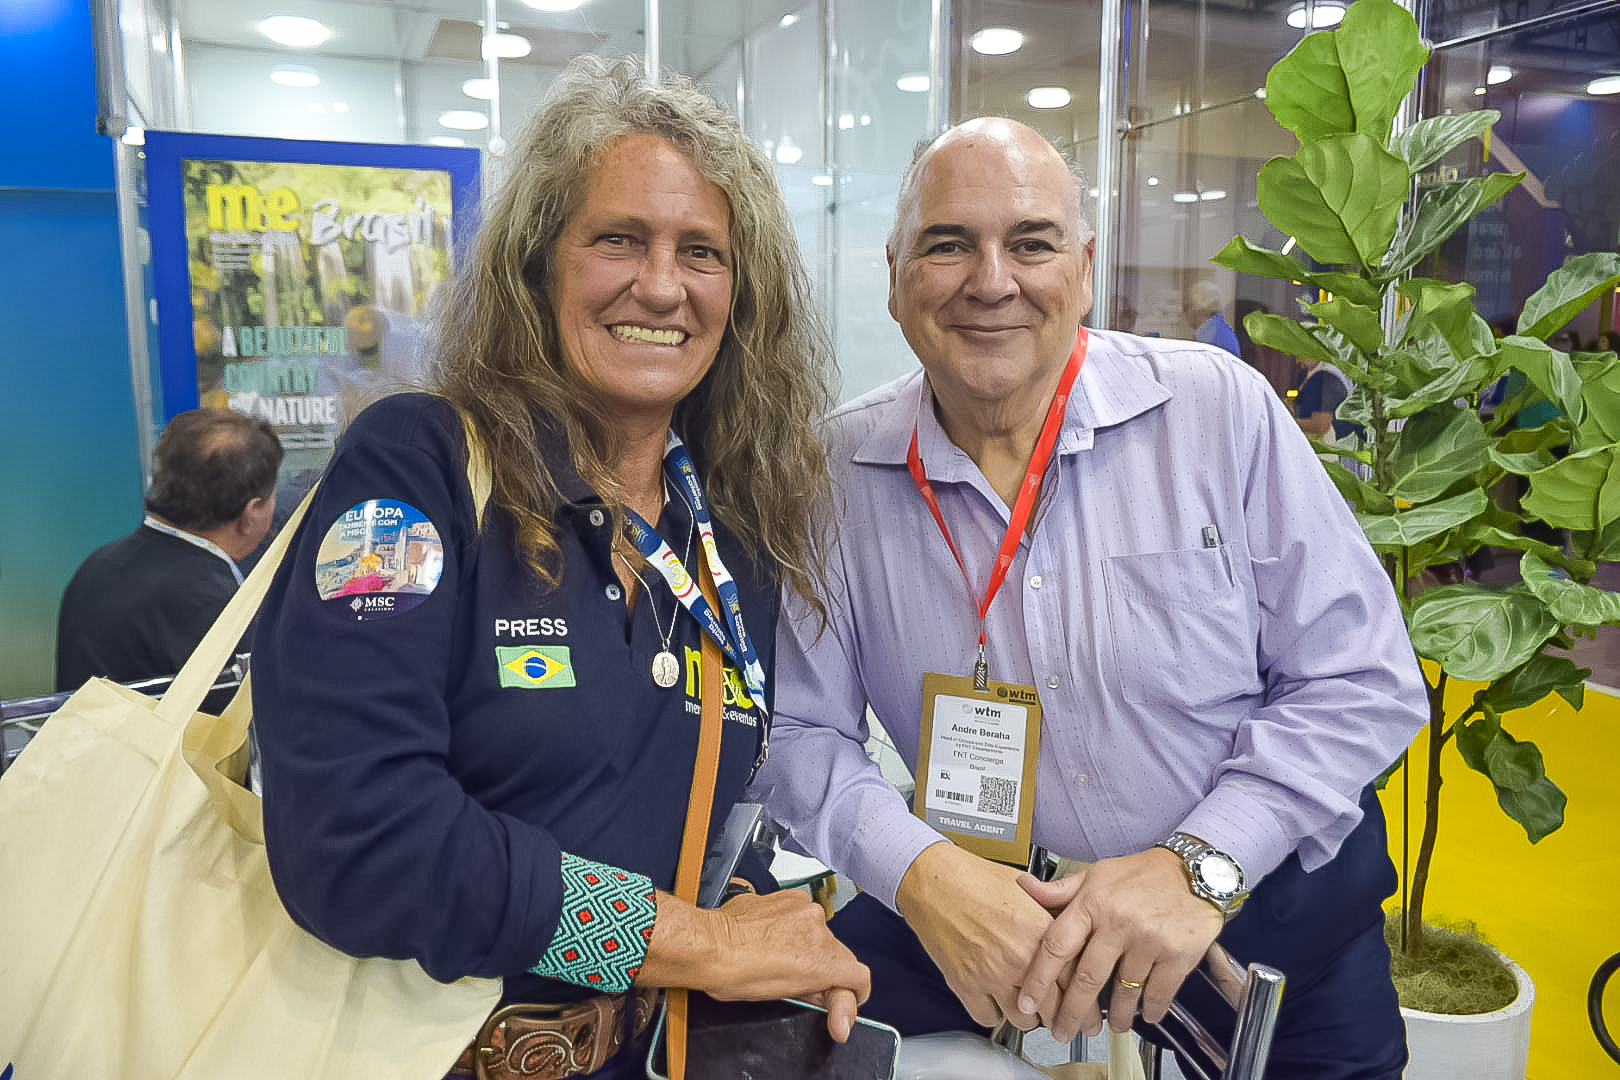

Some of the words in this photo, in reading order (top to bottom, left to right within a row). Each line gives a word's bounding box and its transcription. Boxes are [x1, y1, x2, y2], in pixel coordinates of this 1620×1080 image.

[221, 327, 238, 357] A
[259, 397, 338, 425] NATURE
[345, 507, 404, 522] EUOPA
[364, 596, 396, 608] MSC
[494, 617, 569, 638] PRESS
[1008, 689, 1037, 702] wtm
[974, 706, 1002, 719] wtm
[938, 816, 972, 830] TRAVEL
[974, 823, 1006, 835] AGENT
